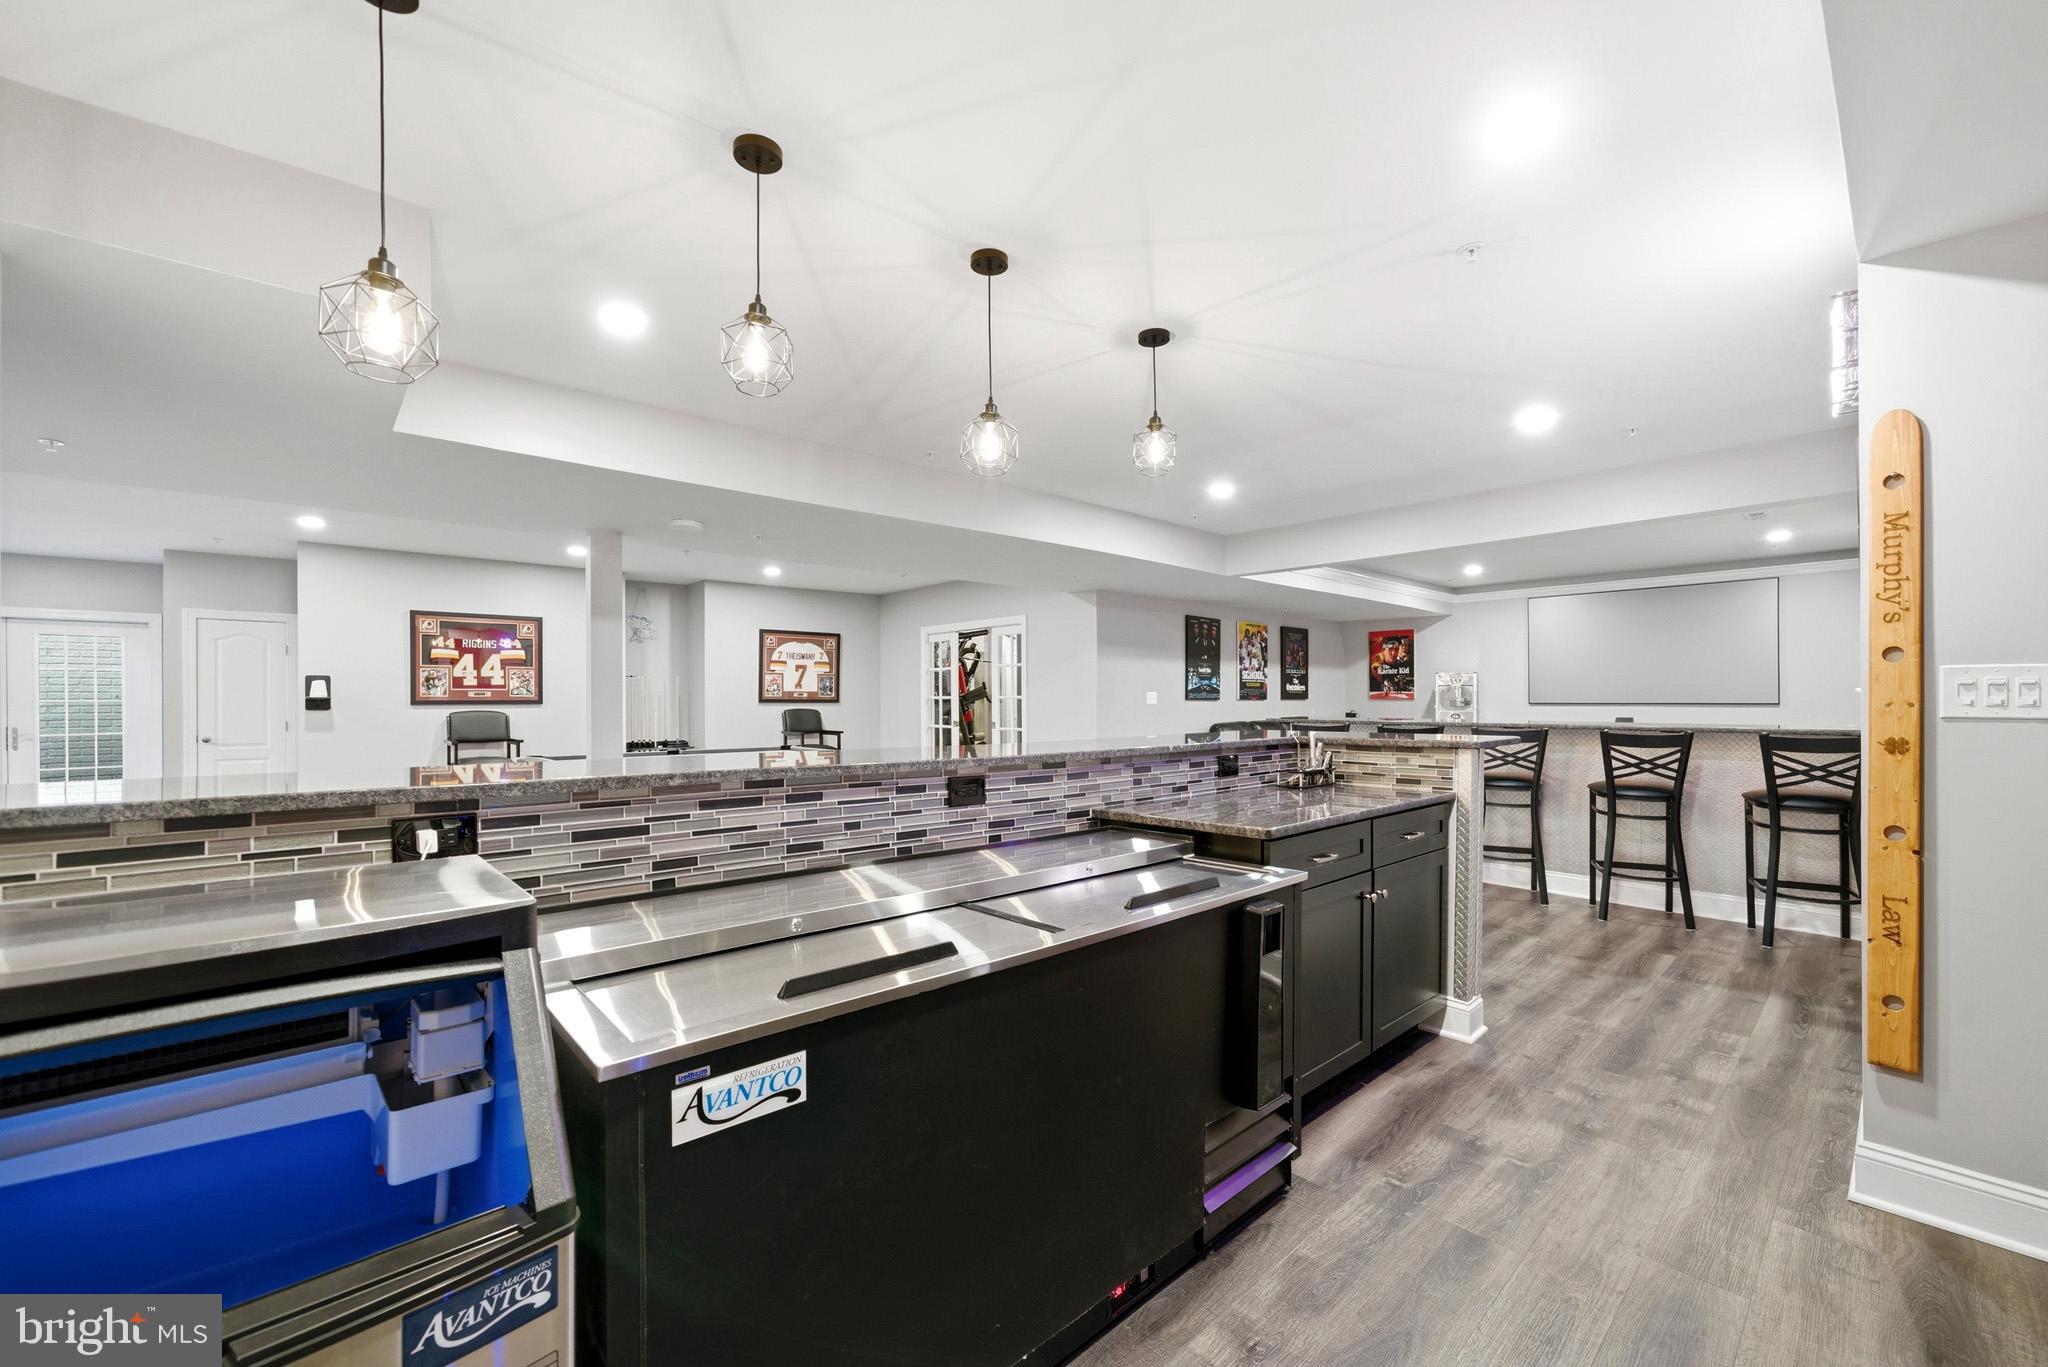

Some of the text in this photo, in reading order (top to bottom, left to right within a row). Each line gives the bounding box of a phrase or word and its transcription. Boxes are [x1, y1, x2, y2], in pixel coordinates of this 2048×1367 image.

[462, 638, 497, 649] RIGGINS
[453, 653, 505, 686] 44
[794, 664, 808, 689] 7
[1876, 510, 1910, 947] Murphy's Law
[733, 1055, 803, 1084] REFRIGERATION
[676, 1065, 802, 1125] AVANTCO
[483, 1258, 552, 1299] ICE MACHINES
[411, 1269, 552, 1355] AVANTCO
